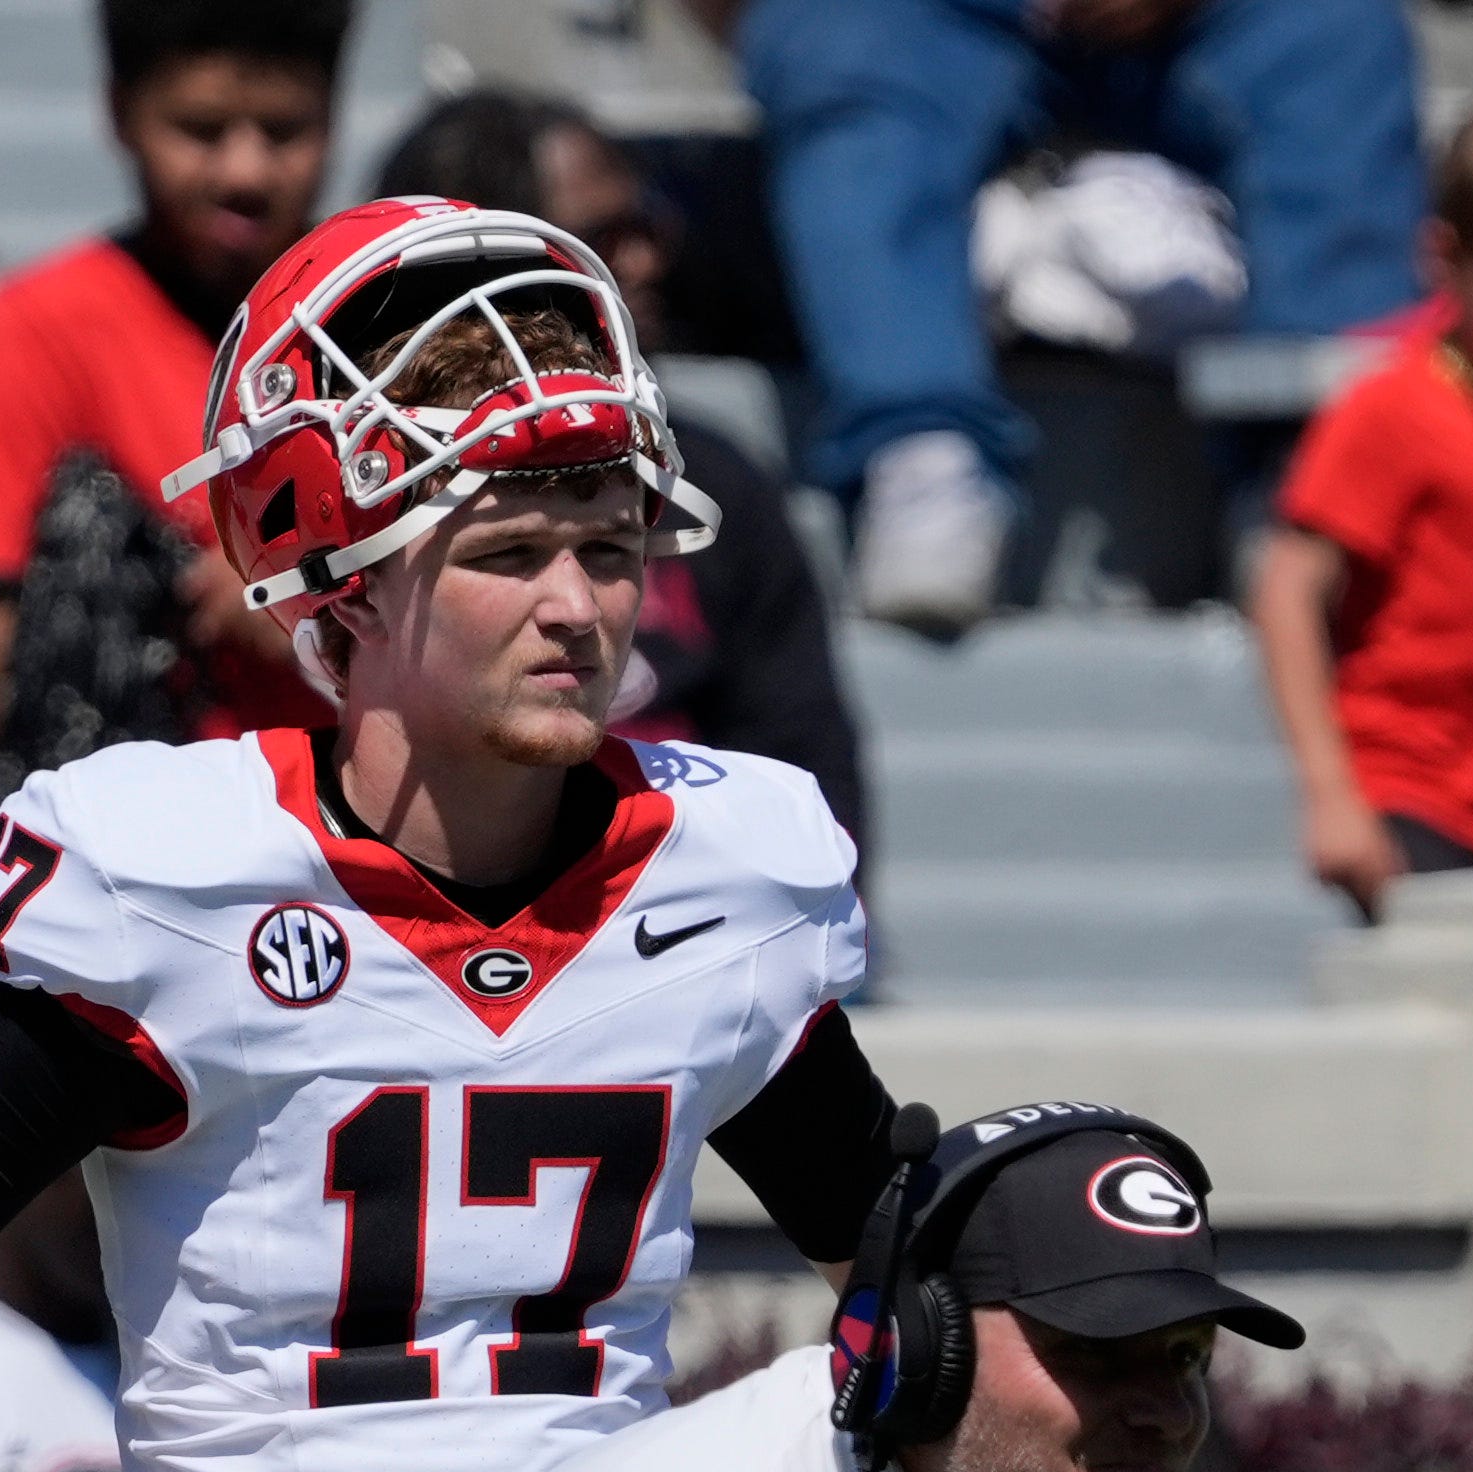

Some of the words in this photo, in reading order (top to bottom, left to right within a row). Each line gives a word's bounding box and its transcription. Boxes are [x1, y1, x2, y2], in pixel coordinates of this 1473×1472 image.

[253, 906, 347, 1001] SEC
[461, 948, 533, 997] G
[1007, 1101, 1129, 1124] DEL
[1088, 1155, 1201, 1236] G
[308, 1084, 672, 1409] 17
